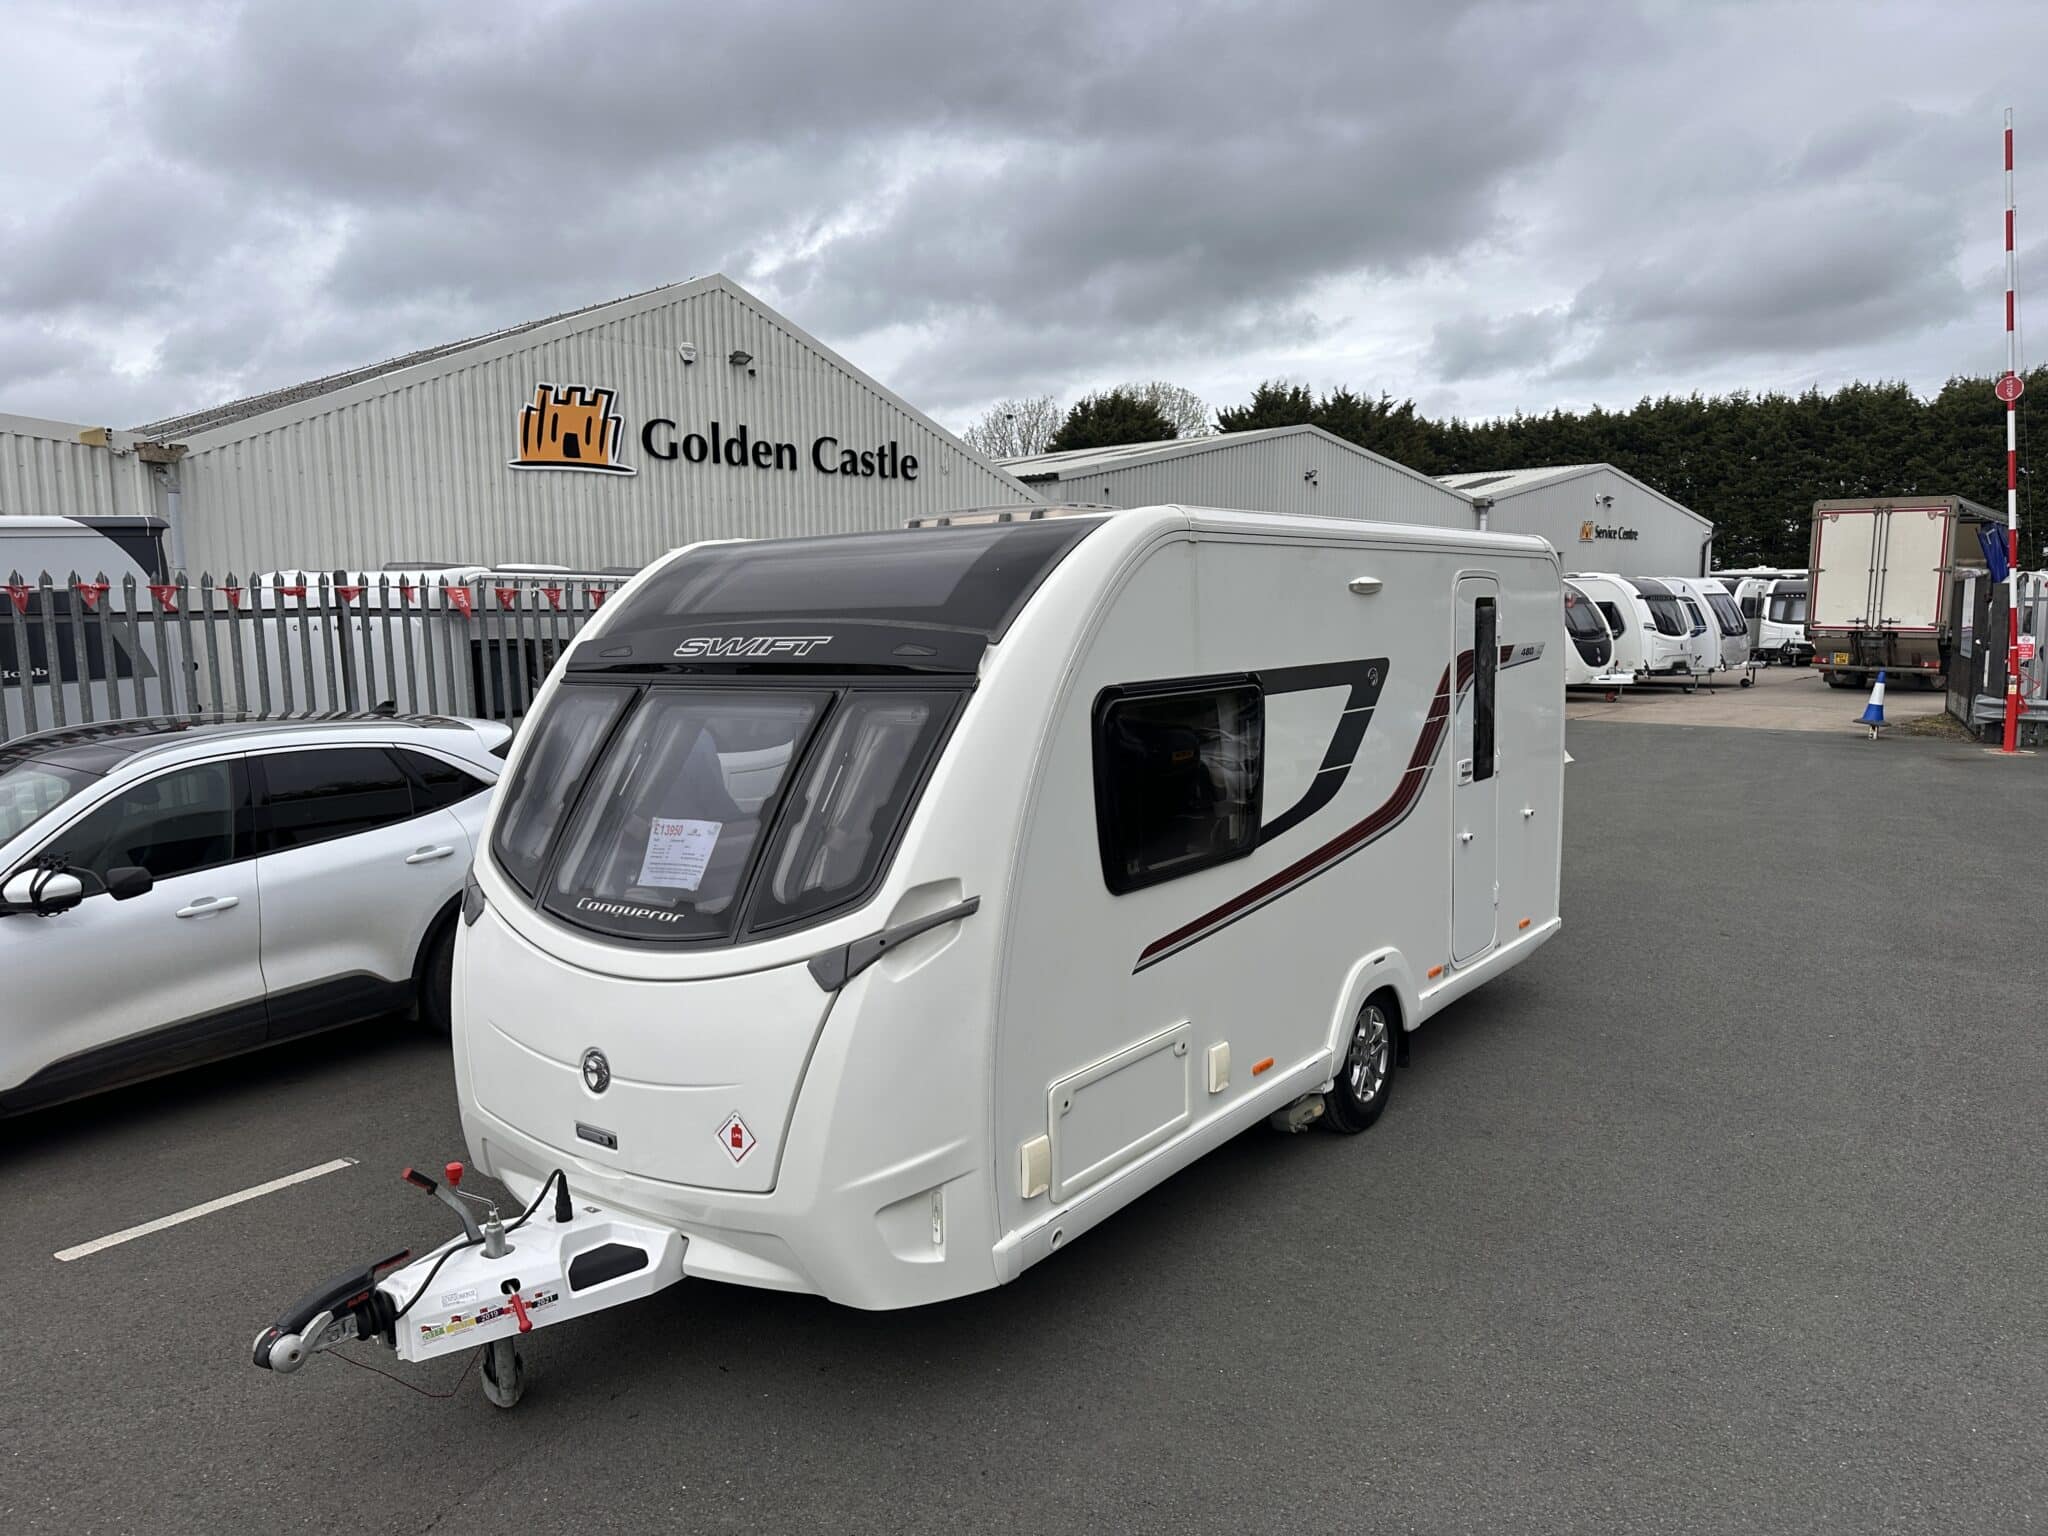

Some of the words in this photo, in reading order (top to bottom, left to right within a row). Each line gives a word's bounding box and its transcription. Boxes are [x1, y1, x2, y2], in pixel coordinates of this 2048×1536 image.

[641, 418, 797, 470] Golden
[812, 436, 918, 481] Castle
[1595, 525, 1617, 539] Service
[1618, 526, 1639, 540] Centre
[673, 635, 834, 657] SWIFT
[576, 897, 685, 922] Conqueror
[481, 1310, 499, 1321] 2019
